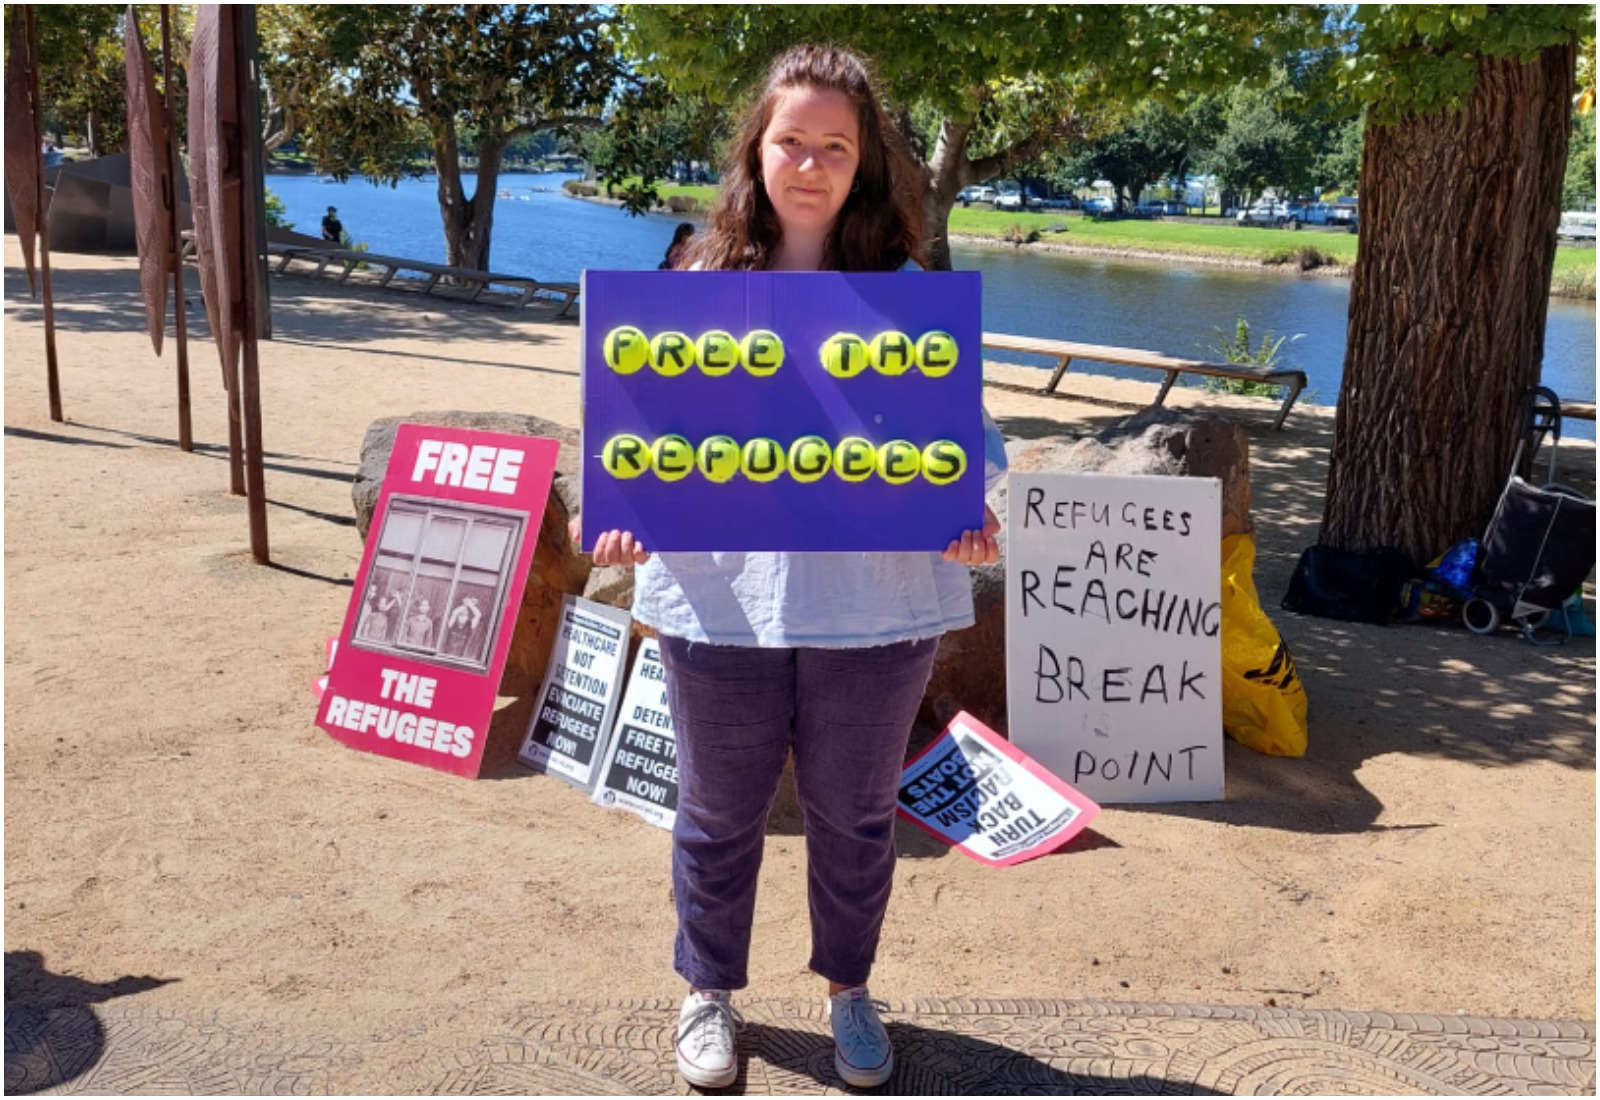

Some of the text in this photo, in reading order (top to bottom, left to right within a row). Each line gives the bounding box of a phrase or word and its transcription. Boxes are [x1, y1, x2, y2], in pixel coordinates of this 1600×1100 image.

[611, 328, 951, 371] FREE THE
[411, 439, 525, 494] FREE
[609, 434, 962, 480] REFUGEES
[1023, 488, 1193, 536] REFUGEES
[1085, 540, 1159, 577] ARE
[1020, 565, 1222, 637] REACHING
[562, 624, 618, 657] HEALTHCARE
[572, 649, 596, 670] NOT
[640, 663, 667, 683] HEA
[1034, 643, 1207, 704] BREAK
[380, 668, 437, 709] THE
[556, 664, 608, 698] DETENTION
[547, 686, 603, 721] EVACUATE
[633, 706, 673, 731] DETEN
[325, 695, 474, 758] REFUGEES
[541, 706, 597, 742] REFUGEES
[625, 730, 661, 755] FREE
[546, 731, 578, 757] NOW!
[615, 749, 679, 784] REFUGEE
[1074, 745, 1208, 786] POINT
[626, 776, 668, 804] NOW!
[911, 785, 957, 814] THE
[936, 766, 1014, 828] RACISM
[966, 791, 1024, 834] BACK
[988, 808, 1047, 847] TURN
